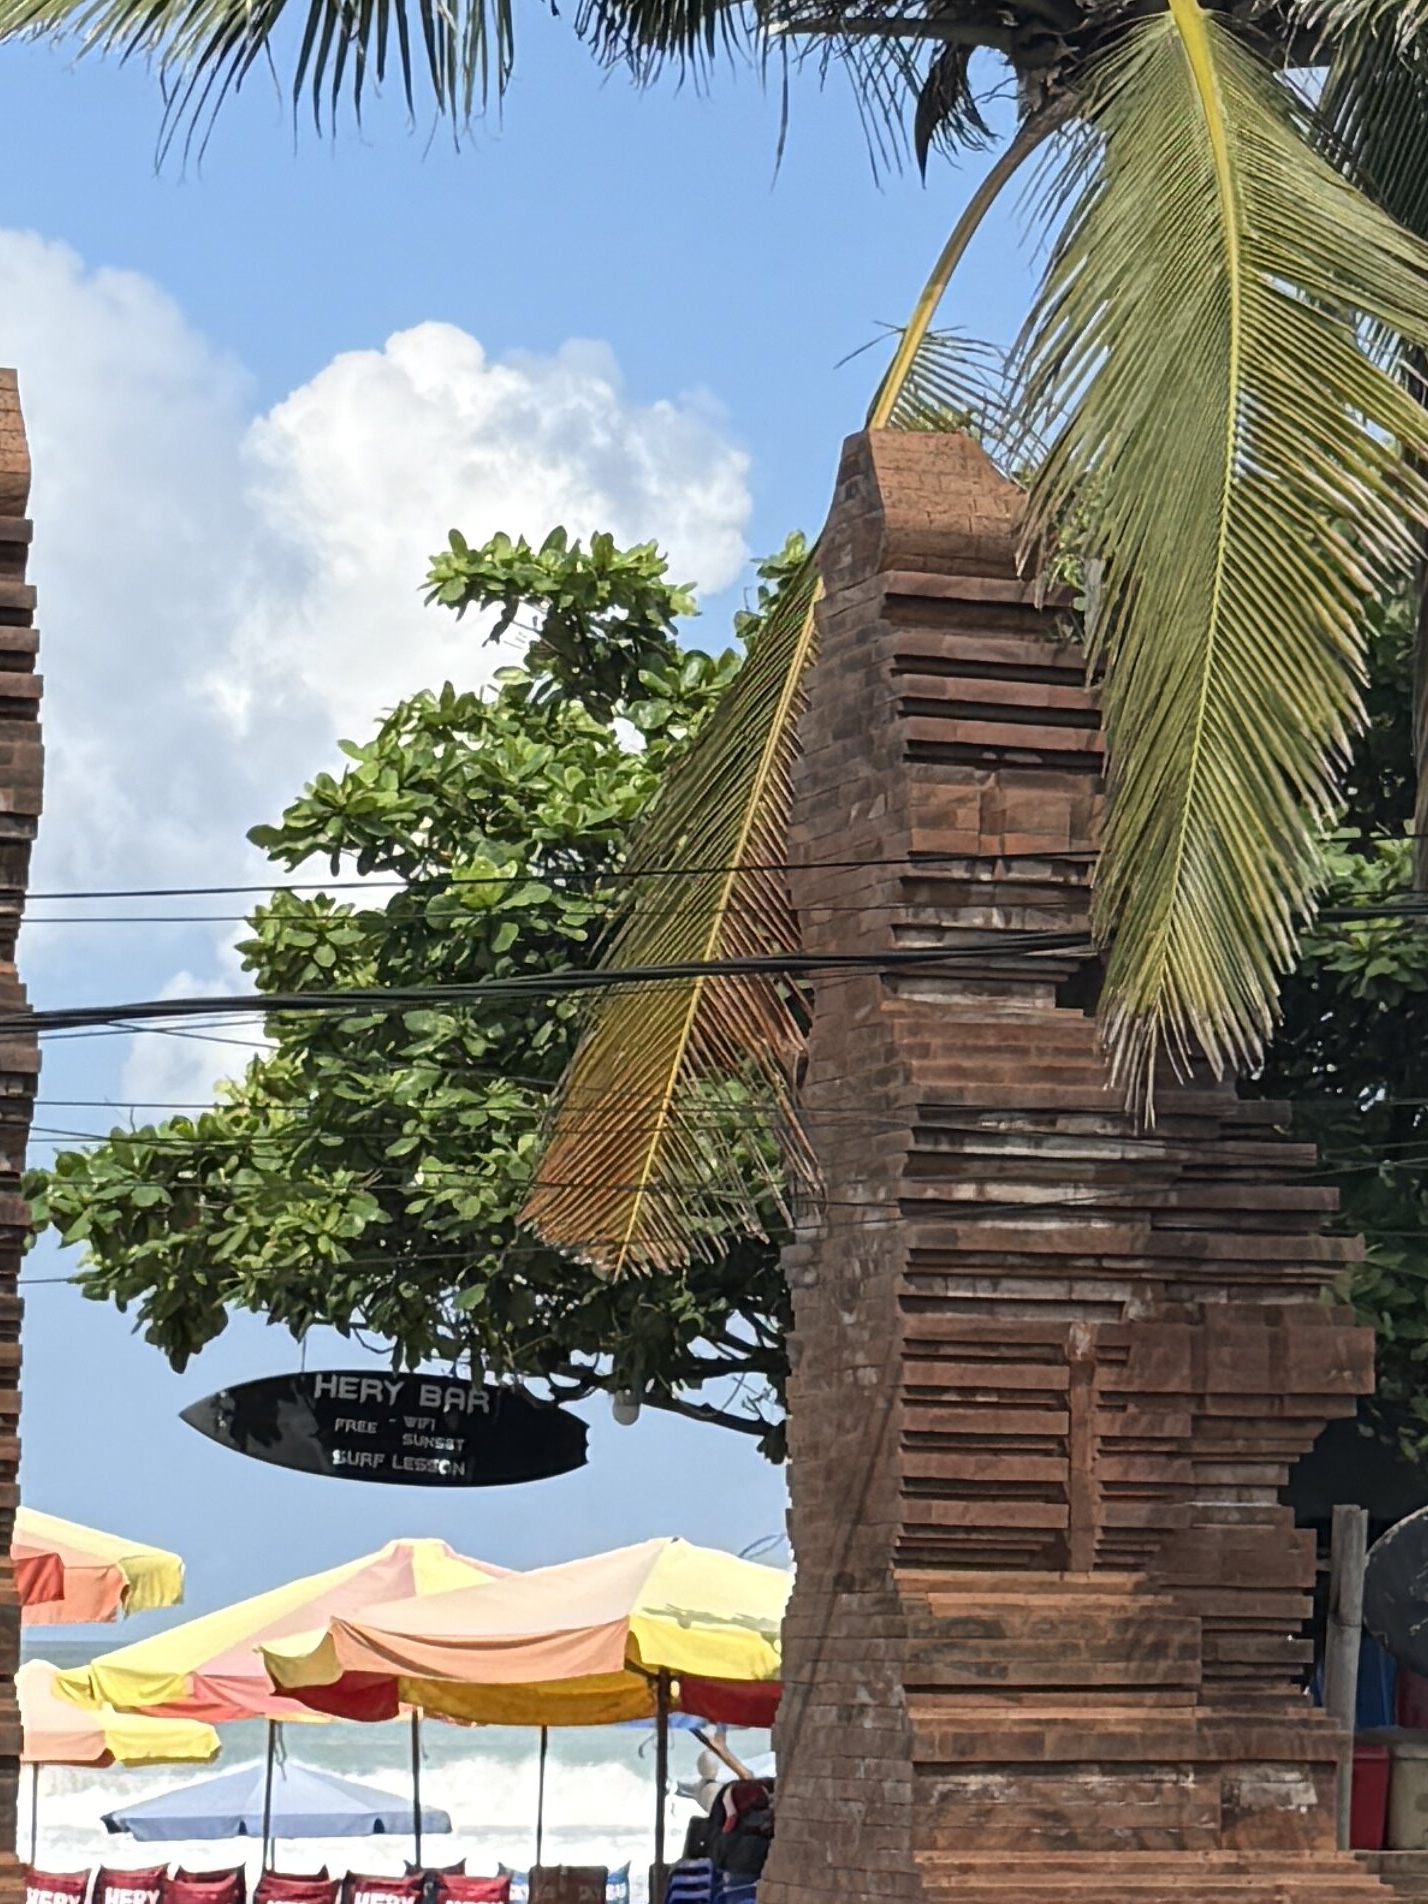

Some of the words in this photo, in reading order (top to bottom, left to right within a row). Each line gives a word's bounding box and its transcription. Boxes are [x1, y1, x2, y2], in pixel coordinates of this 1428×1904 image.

[314, 1374, 405, 1406] HERY
[419, 1385, 490, 1414] BAR
[334, 1417, 378, 1434] FREE
[332, 1448, 385, 1469] SURF
[392, 1454, 465, 1476] LESSON
